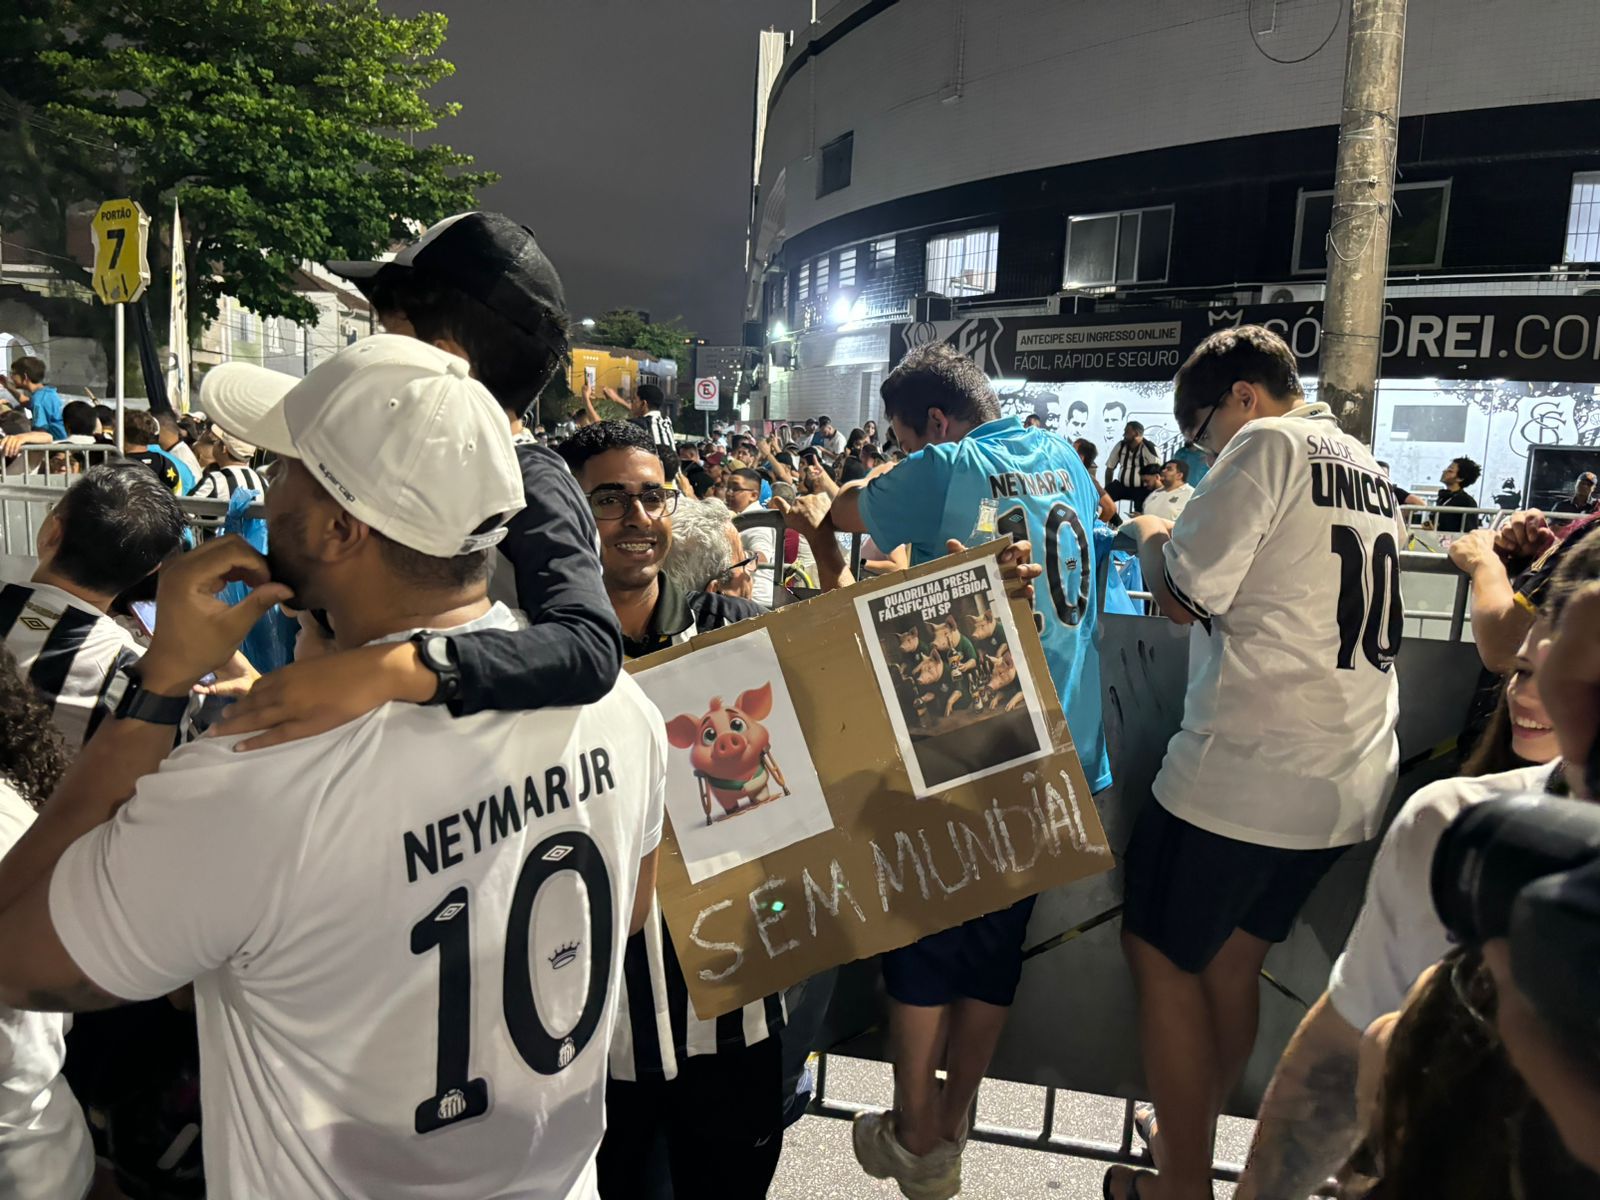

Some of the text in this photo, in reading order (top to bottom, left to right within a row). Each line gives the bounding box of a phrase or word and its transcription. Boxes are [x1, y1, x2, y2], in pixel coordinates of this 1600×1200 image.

[101, 207, 132, 221] PORTÃO
[107, 228, 125, 270] 7
[1020, 327, 1177, 346] ANTECIPE SEU INGRESSO ONLINE
[1013, 350, 1180, 371] FÁCIL, RÁPIDO E SEGURO
[878, 578, 988, 622] FALSIFICANDO BEBIDA
[884, 570, 976, 609] QUADRILHA PRESA
[1331, 523, 1403, 674] 10
[921, 602, 951, 621] EM SP
[403, 747, 615, 883] NEYMAR JR
[689, 858, 866, 983] SEM
[410, 831, 613, 1134] 10
